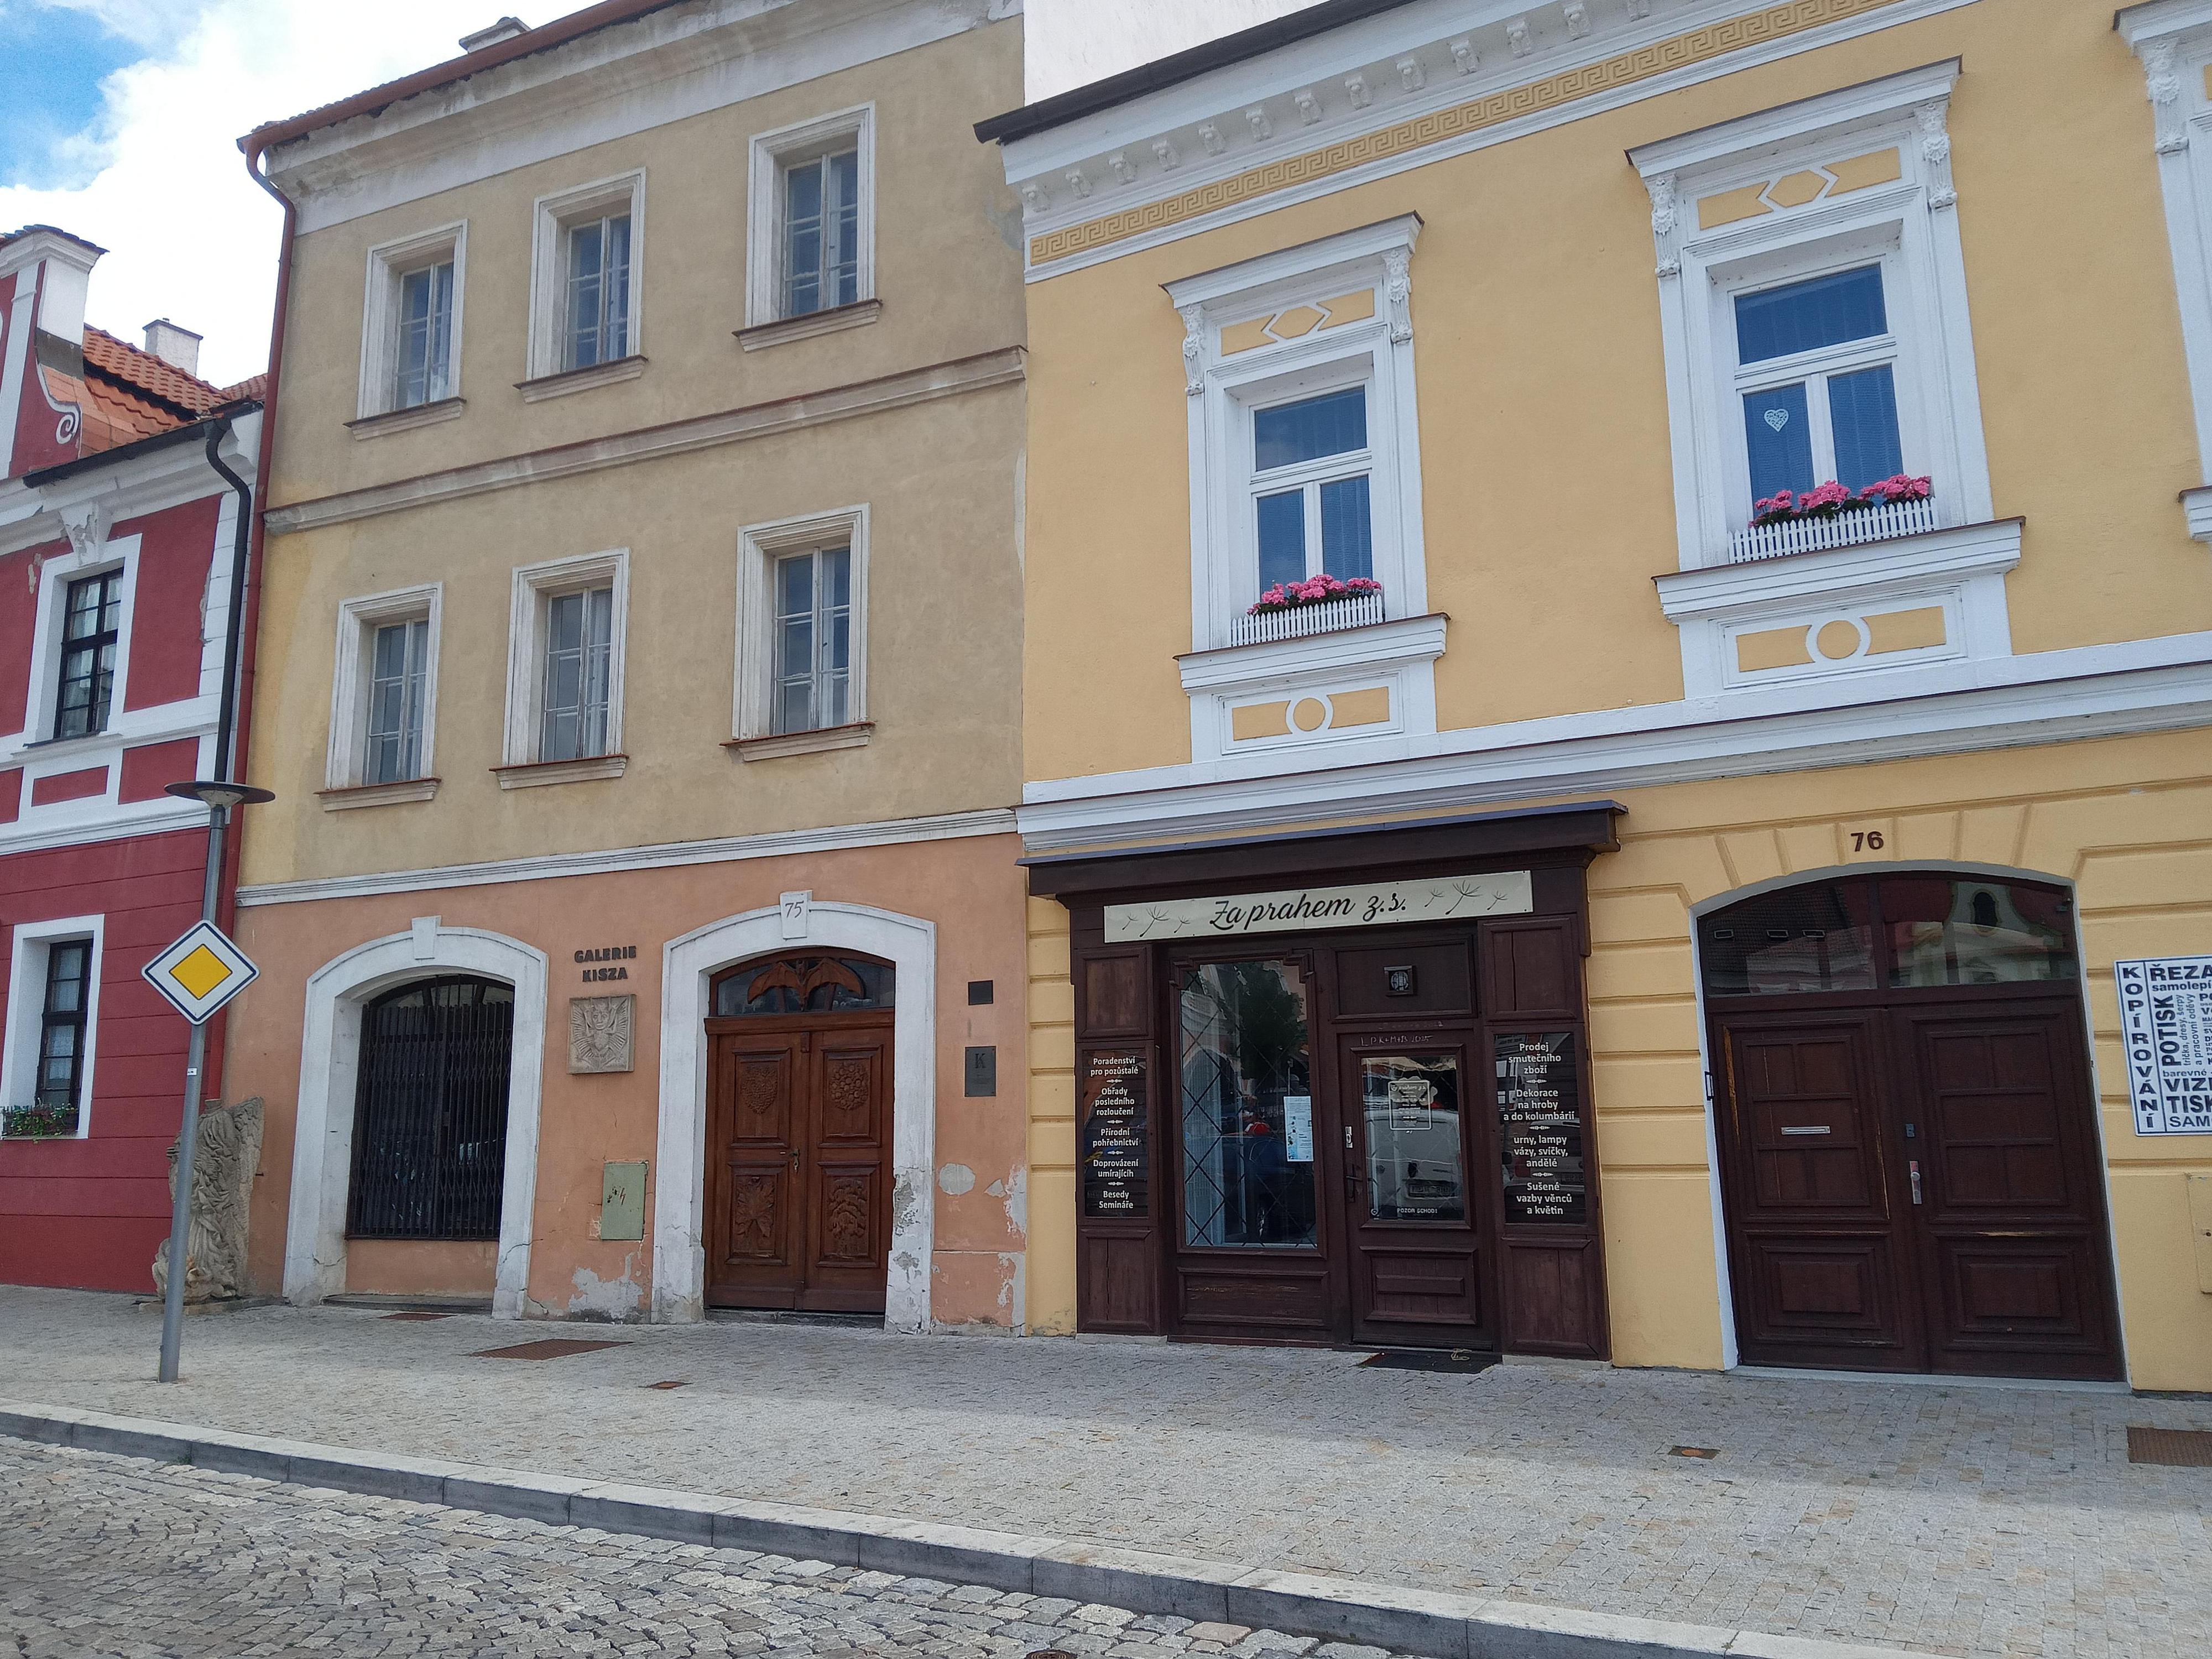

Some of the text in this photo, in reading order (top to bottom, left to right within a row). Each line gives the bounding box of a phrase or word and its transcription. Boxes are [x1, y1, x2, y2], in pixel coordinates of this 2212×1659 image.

[1850, 831, 1884, 852] 76
[785, 900, 804, 918] 75
[1244, 893, 1355, 930] prahem
[575, 946, 637, 963] GALERIE
[582, 967, 628, 982] KISZA
[2153, 995, 2182, 1066] POTISK
[1519, 1042, 1549, 1053] Prodej
[1093, 1056, 1135, 1065] Poradenství
[1508, 1053, 1562, 1063] smutečního
[1104, 1065, 1139, 1077] pozůstalé
[1524, 1065, 1547, 1074] zboží
[1101, 1087, 1128, 1096] Obřady
[1516, 1089, 1558, 1097] Dekorace
[1095, 1097, 1135, 1107] posledního
[1531, 1099, 1558, 1111] hroby
[1096, 1107, 1134, 1116] rozloučení
[1511, 1112, 1523, 1120] do
[1525, 1110, 1574, 1120] kolumbárií
[1100, 1127, 1130, 1136] Přírodní
[1092, 1137, 1139, 1148] pohřebnictví
[1514, 1135, 1567, 1146] urny, lampy
[1514, 1146, 1568, 1157] vázy, svíčky,
[1093, 1158, 1139, 1168] Doprovázení
[1526, 1159, 1557, 1167] andělé
[1527, 1181, 1559, 1191] Sušené
[1103, 1191, 1129, 1200] Besedy
[1516, 1193, 1572, 1204] vazby věnců
[1099, 1200, 1134, 1209] Semináře
[1534, 1205, 1563, 1214] květin
